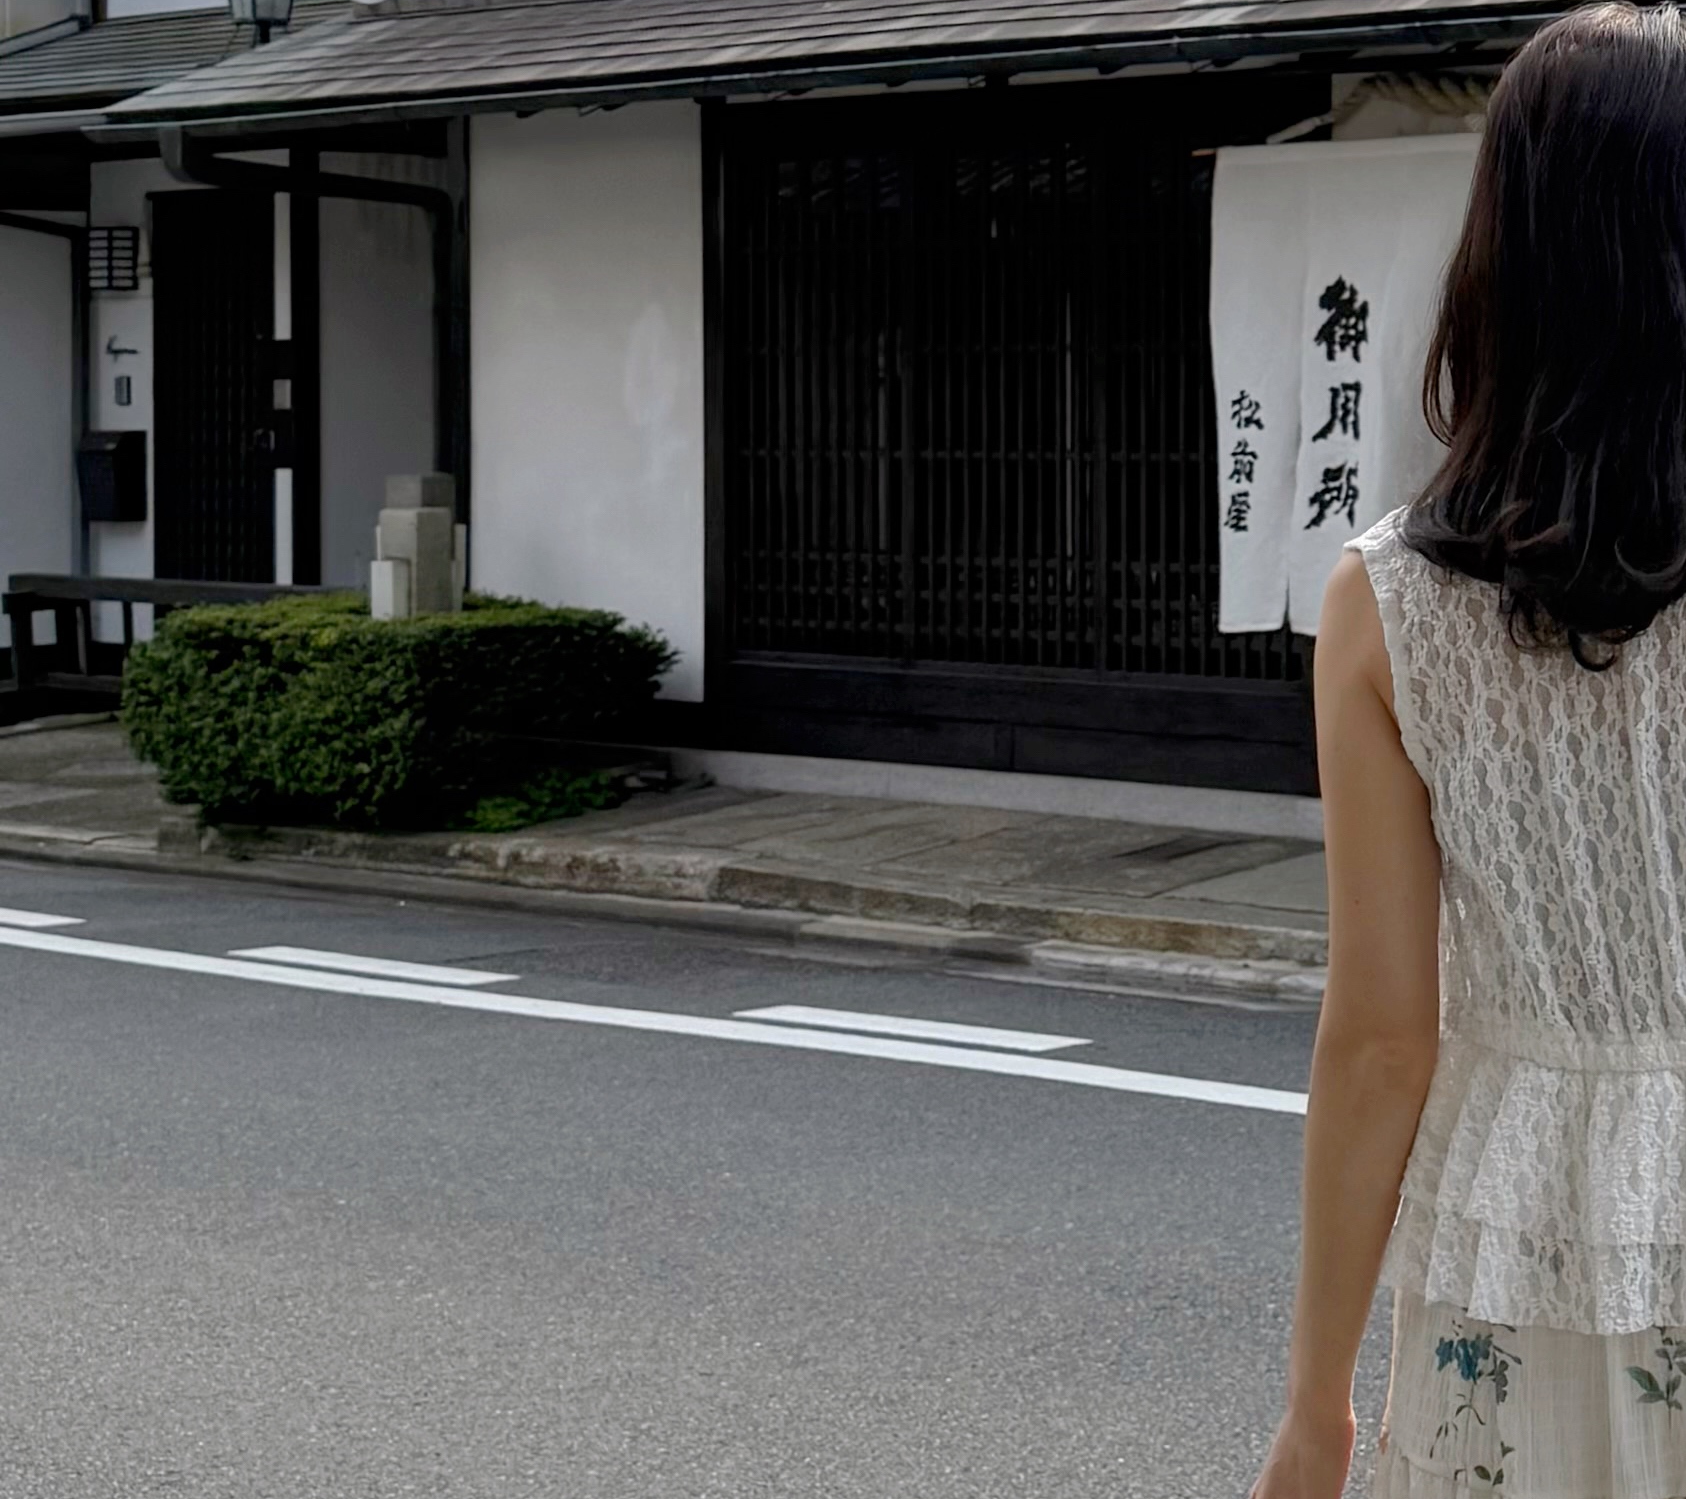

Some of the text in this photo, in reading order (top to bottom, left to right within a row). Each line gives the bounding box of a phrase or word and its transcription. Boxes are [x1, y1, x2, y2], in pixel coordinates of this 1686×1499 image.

[1223, 389, 1265, 533] 松前屋
[1303, 275, 1370, 530] 御用所
